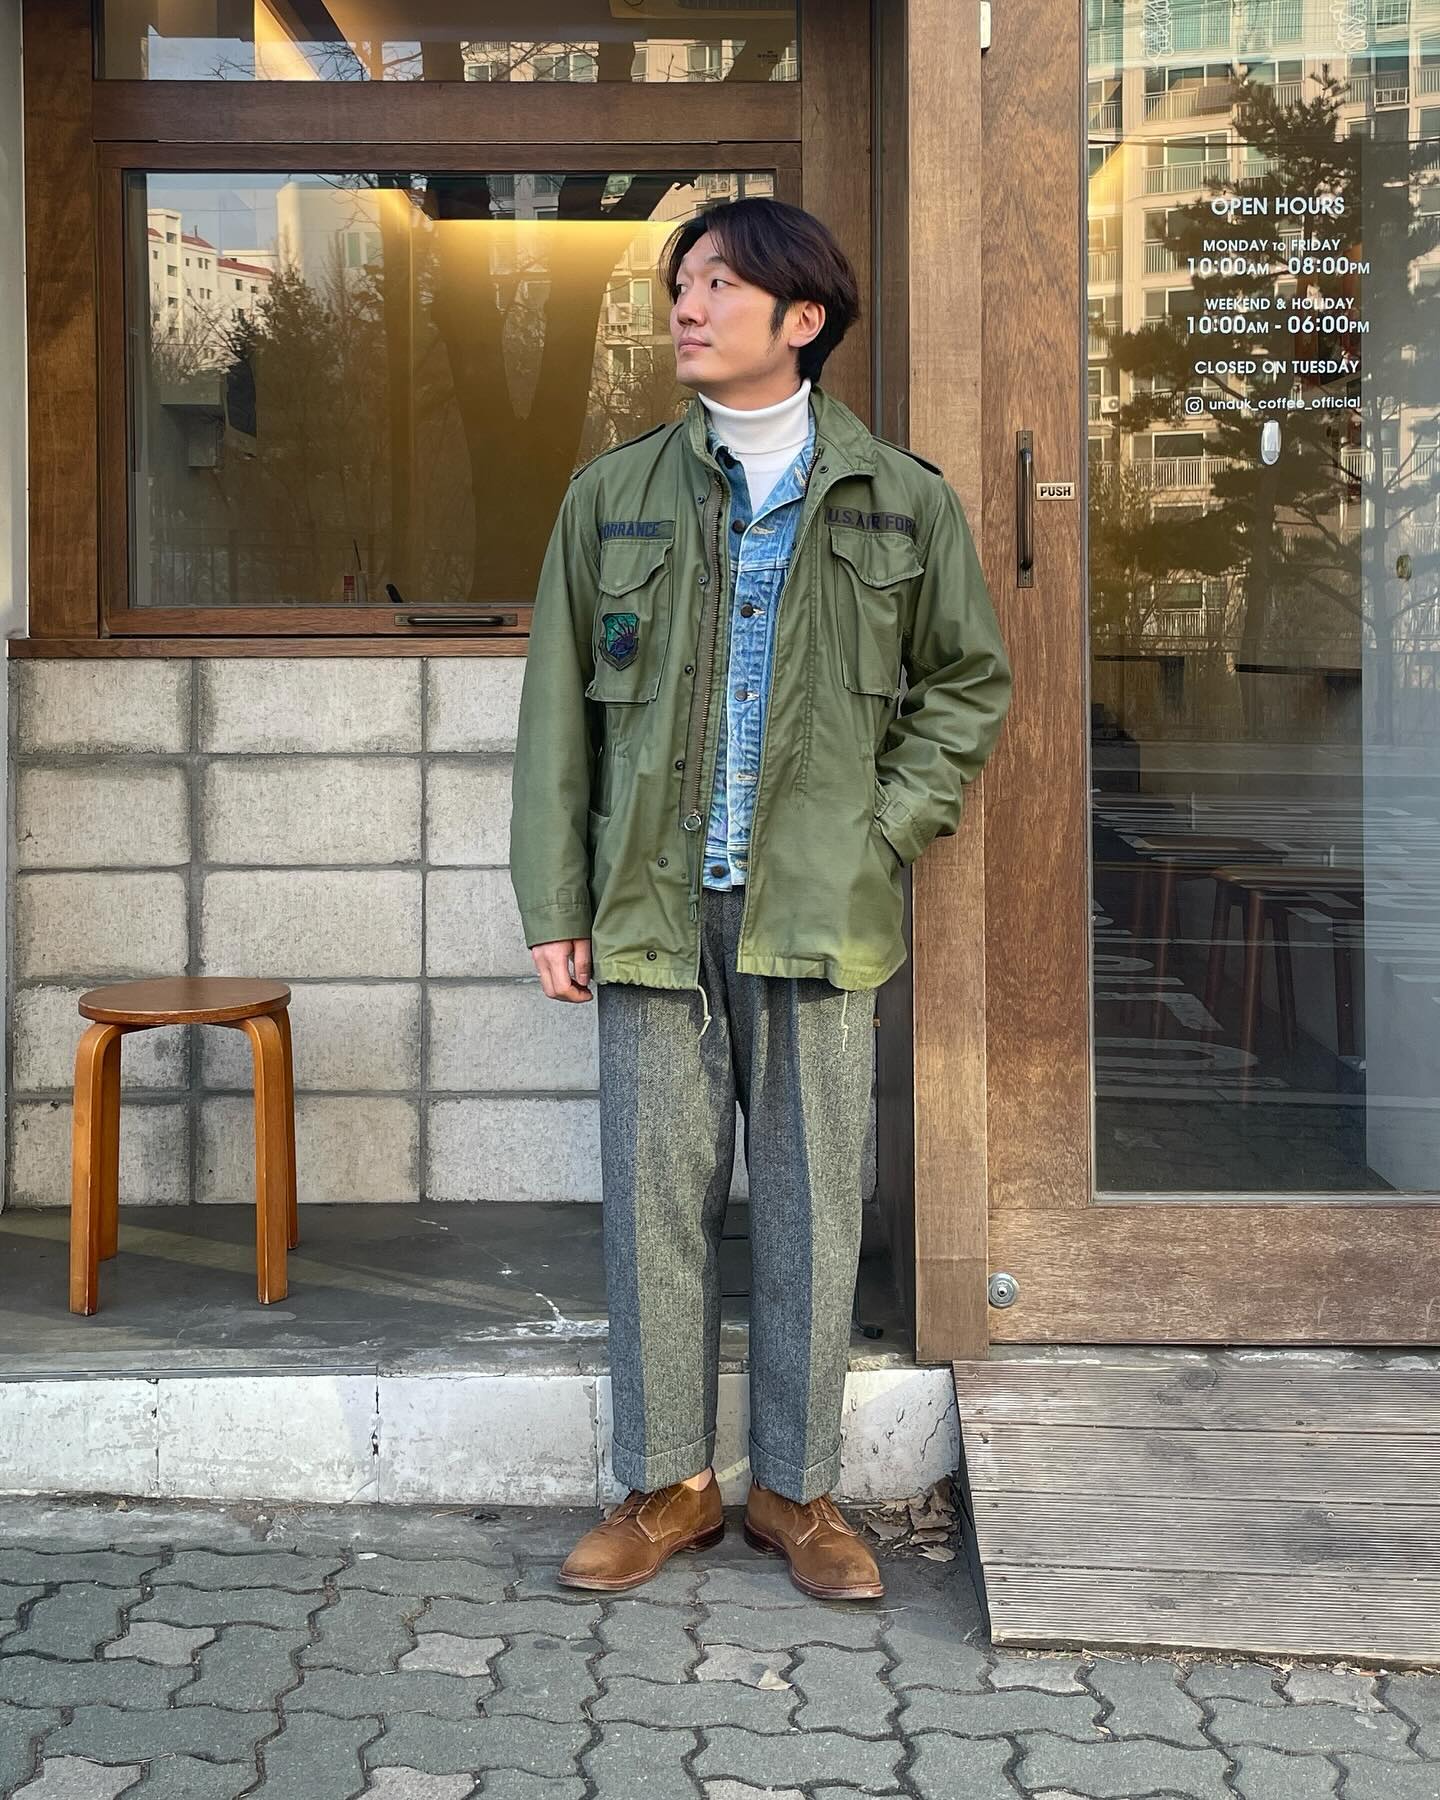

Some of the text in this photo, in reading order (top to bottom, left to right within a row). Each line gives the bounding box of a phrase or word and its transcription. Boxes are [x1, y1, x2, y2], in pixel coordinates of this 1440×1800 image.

[1211, 196, 1345, 216] OPEN HOURS
[1203, 240, 1268, 252] MONDAY
[1291, 239, 1341, 251] FRIDAY
[1187, 258, 1269, 275] 10:00AM
[1288, 257, 1370, 274] 08:00PM
[1205, 298, 1354, 310] WEEKEND & HOLIDAY
[1187, 317, 1269, 334] 10:00AM
[1287, 316, 1370, 333] 06:00PM
[1194, 361, 1360, 375] CLOSED ON TUESDAY
[1209, 397, 1361, 411] unduk_coffee_official
[1040, 486, 1071, 497] PUSH
[600, 522, 658, 539] ORRANCE
[885, 515, 916, 535] FOR
